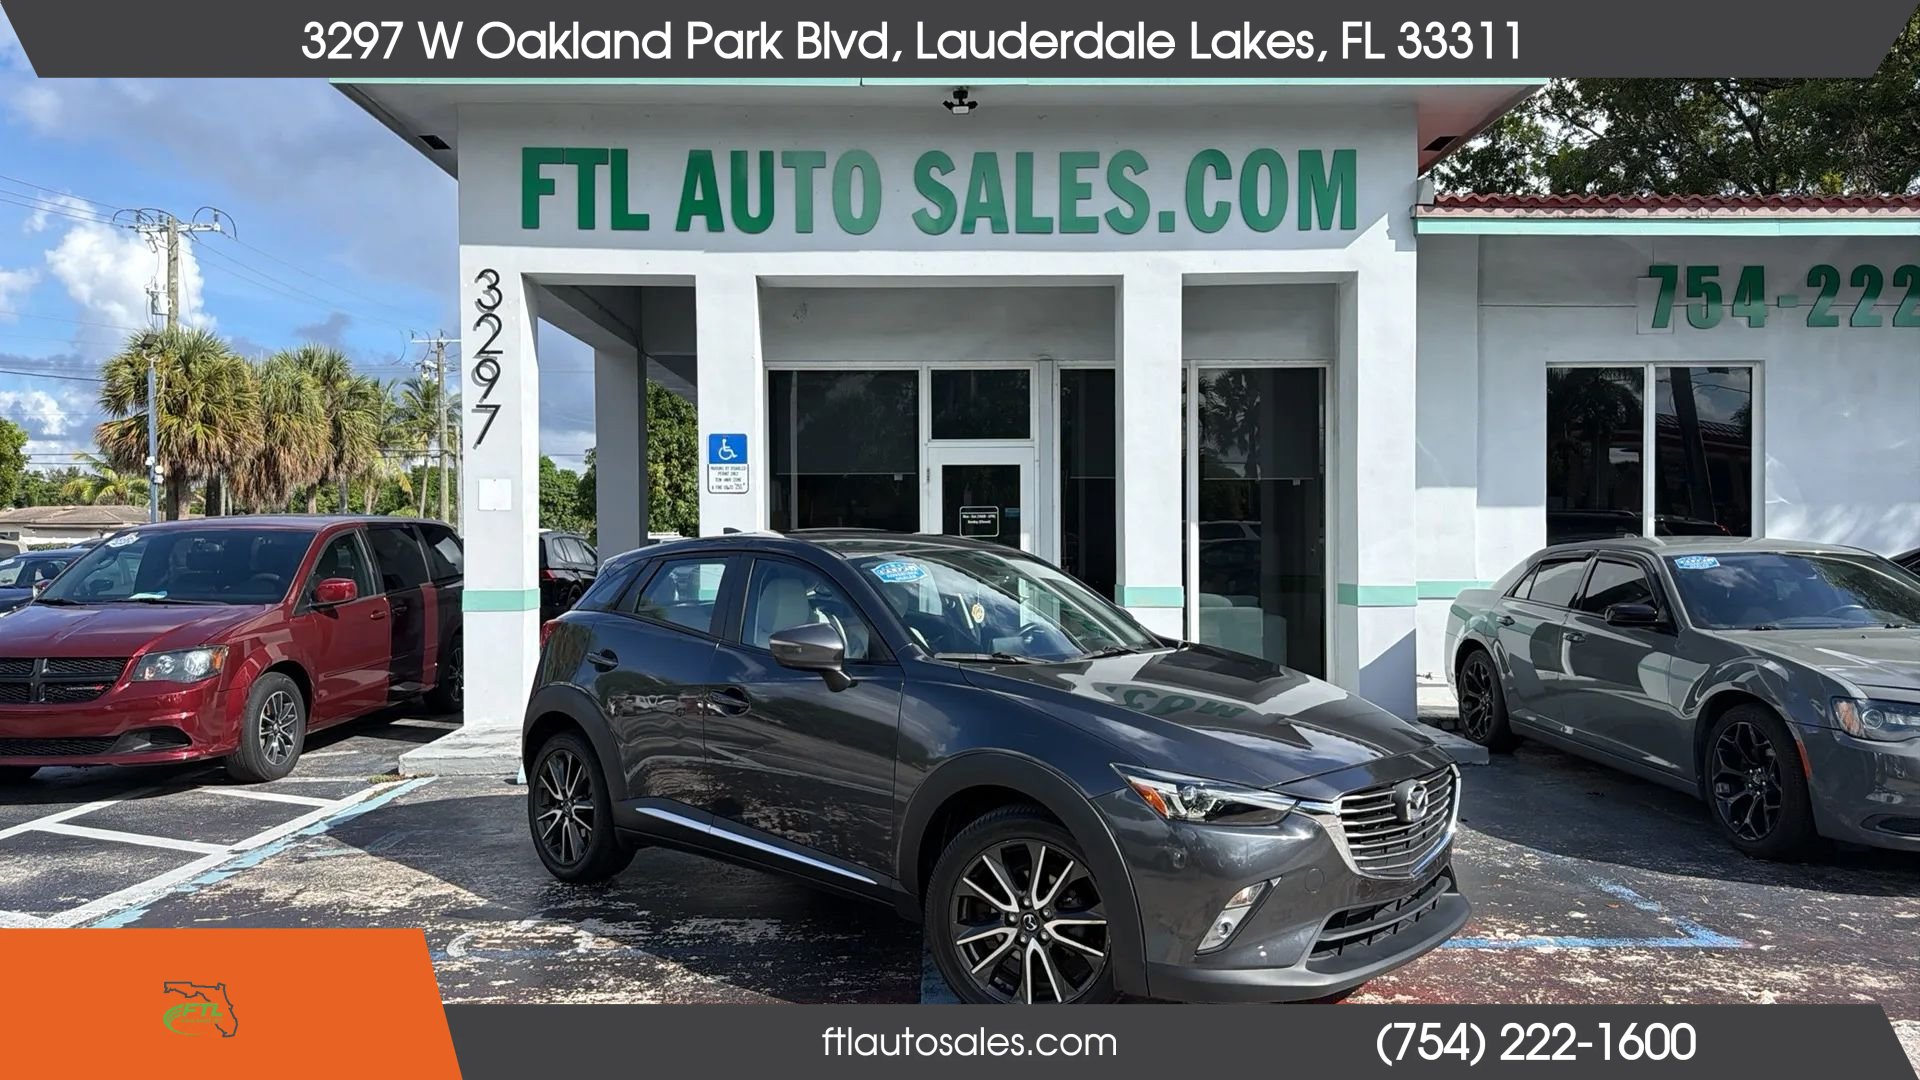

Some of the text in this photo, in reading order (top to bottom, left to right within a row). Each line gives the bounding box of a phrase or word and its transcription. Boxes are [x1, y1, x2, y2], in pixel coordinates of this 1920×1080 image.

[521, 146, 1357, 236] FTL AUTO SALES.COM
[1648, 264, 1920, 329] 754-222
[474, 268, 503, 447] 3297
